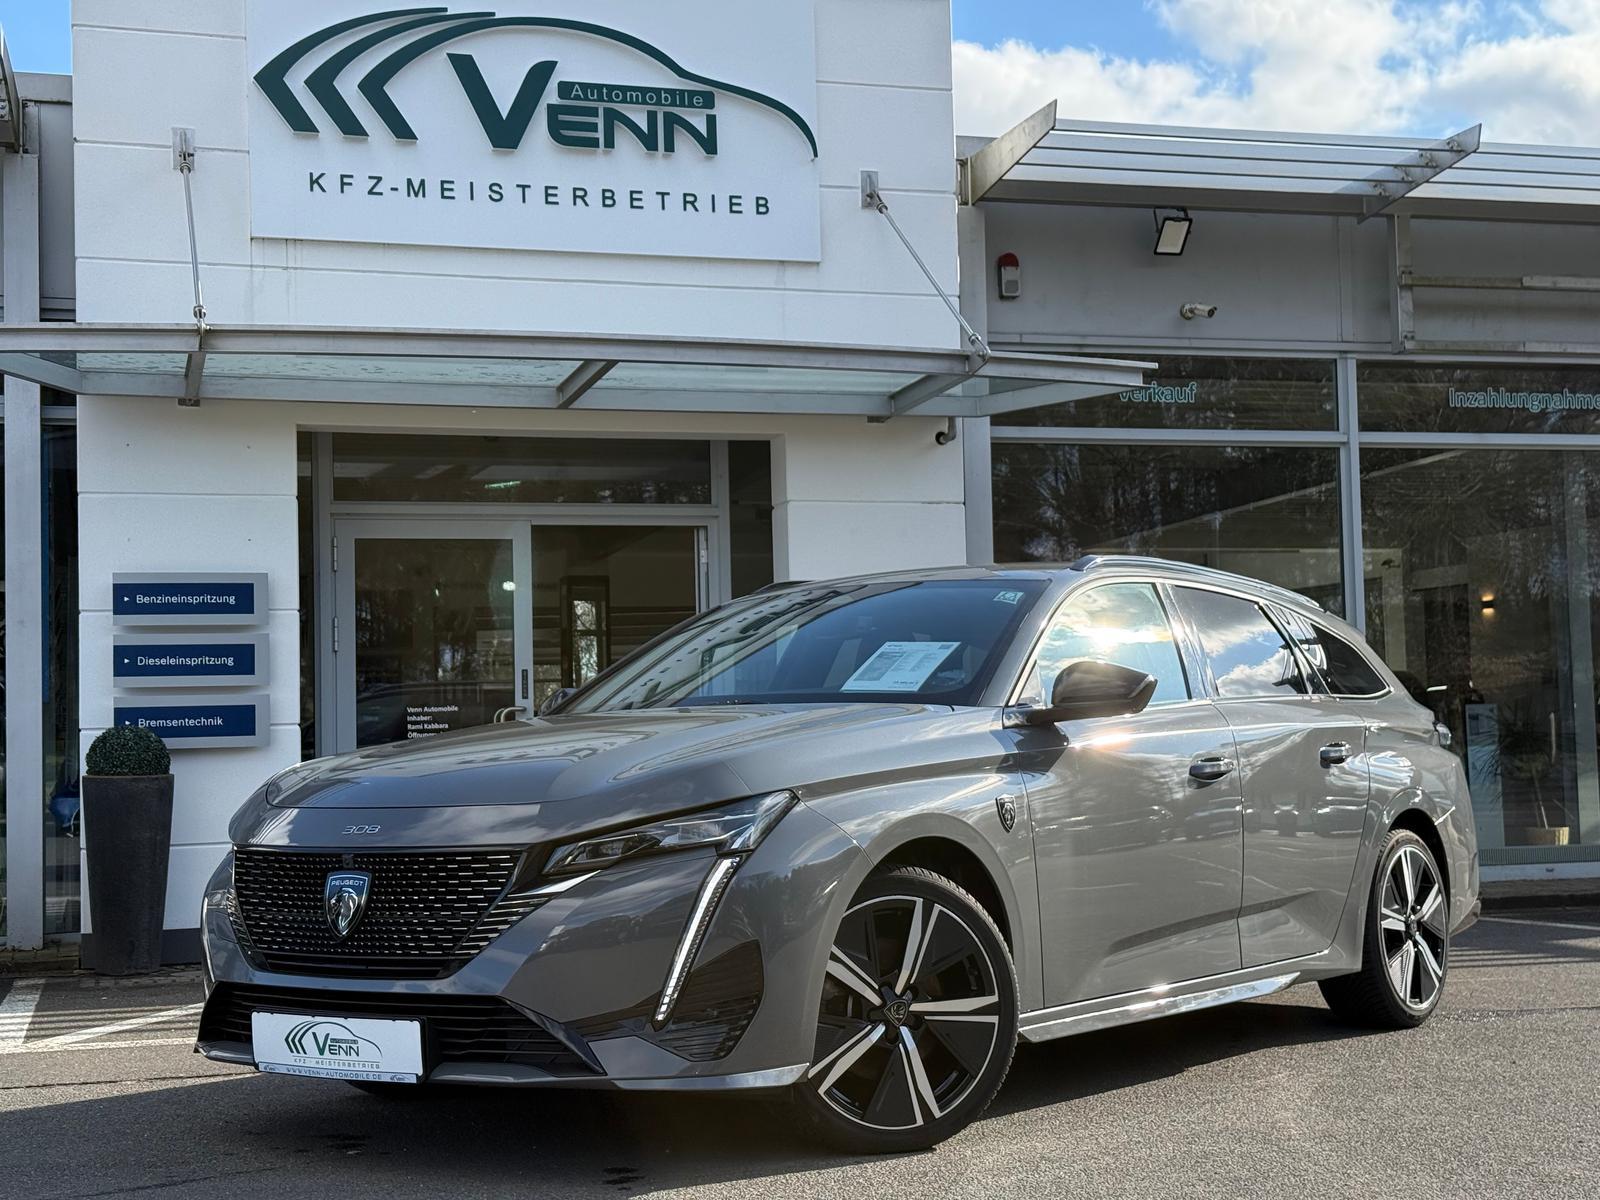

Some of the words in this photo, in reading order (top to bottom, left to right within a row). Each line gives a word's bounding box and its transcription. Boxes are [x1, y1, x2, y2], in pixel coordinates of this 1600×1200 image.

[571, 83, 704, 108] Automobile
[309, 172, 771, 216] KFZ-MEISTERBETRIEB
[1449, 387, 1600, 413] Inzahlungnahme
[136, 594, 236, 605] Benzineinspritzung
[137, 656, 235, 667] Dieseleinspritzung
[424, 704, 459, 712] Automobile
[138, 716, 224, 728] Bremsentechnik
[342, 825, 382, 834] 308
[331, 879, 364, 887] PEUGEOT
